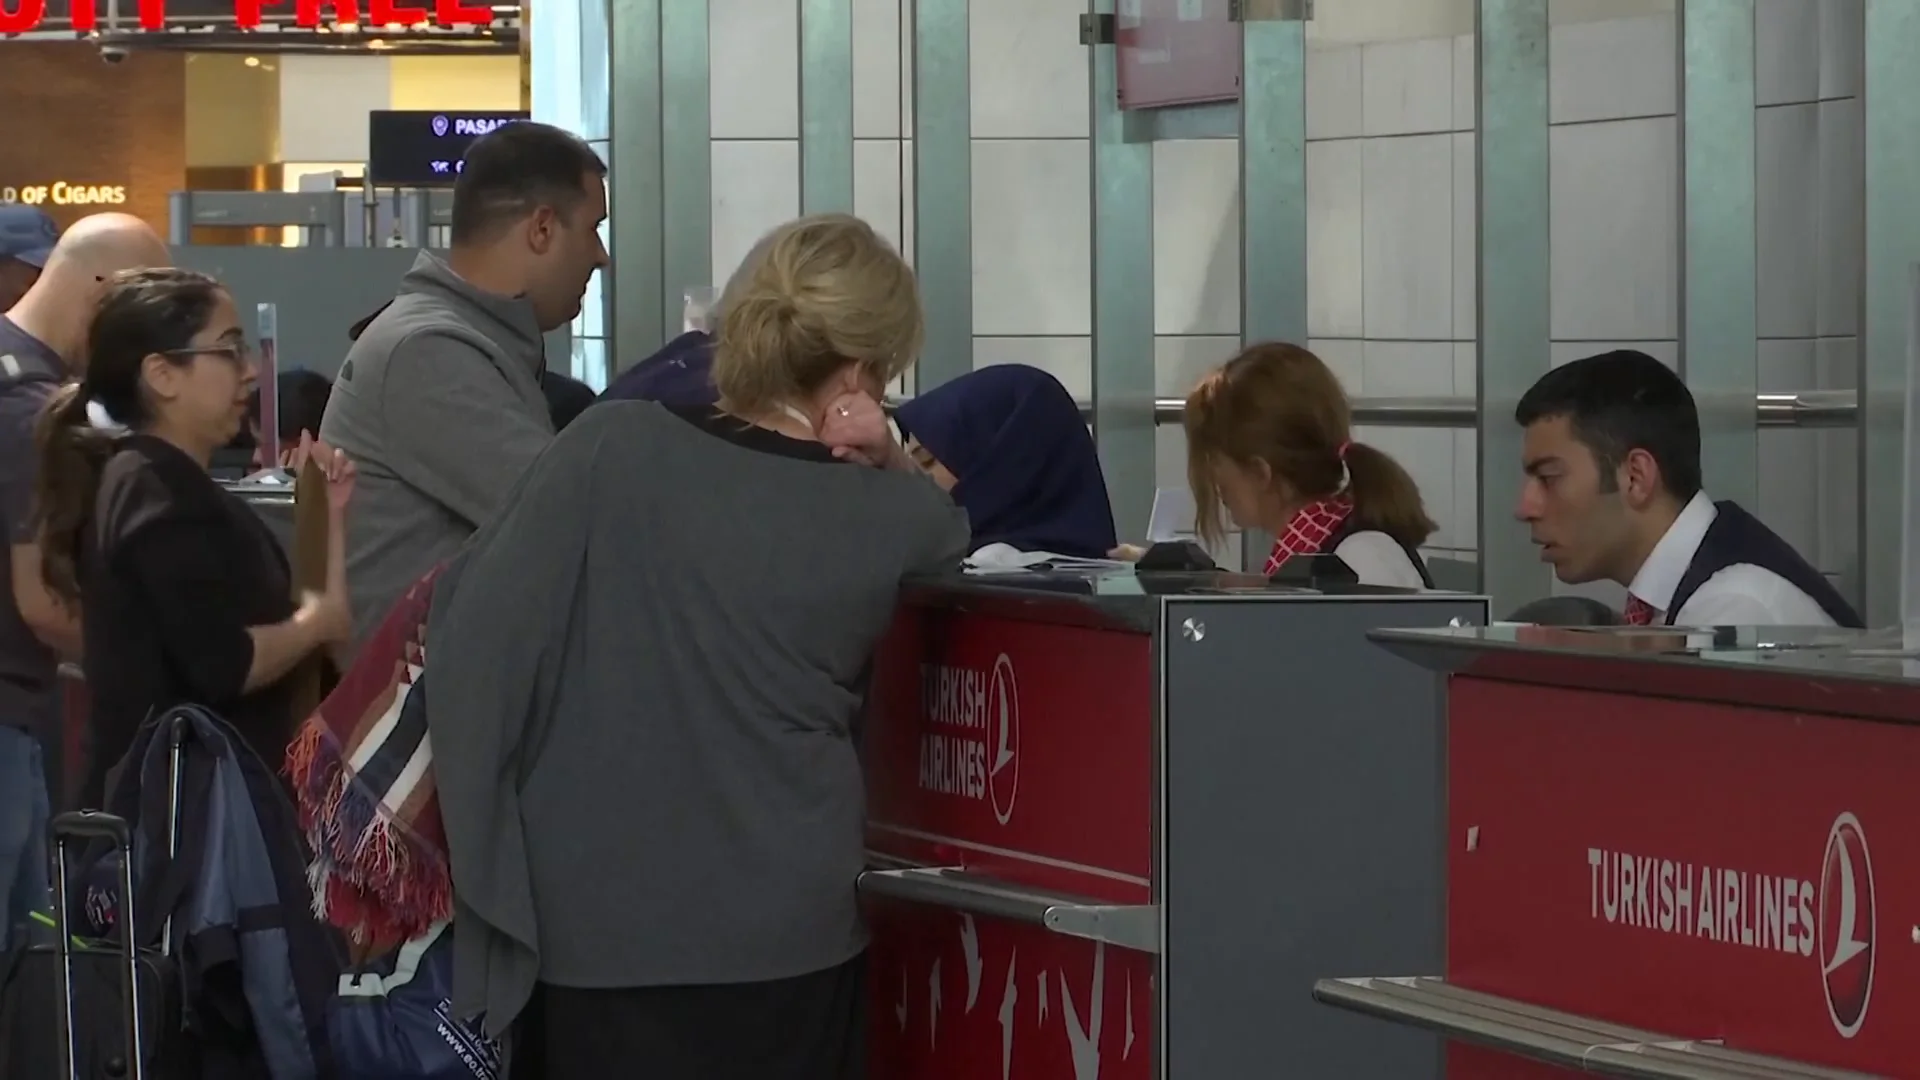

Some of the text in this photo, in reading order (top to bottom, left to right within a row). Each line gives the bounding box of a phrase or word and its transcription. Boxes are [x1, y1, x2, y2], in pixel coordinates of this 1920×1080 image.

[21, 186, 48, 204] OF
[919, 662, 986, 729] TURKISH
[919, 733, 986, 800] AIRLINES
[1588, 848, 1815, 957] TURKISH AIRLINES
